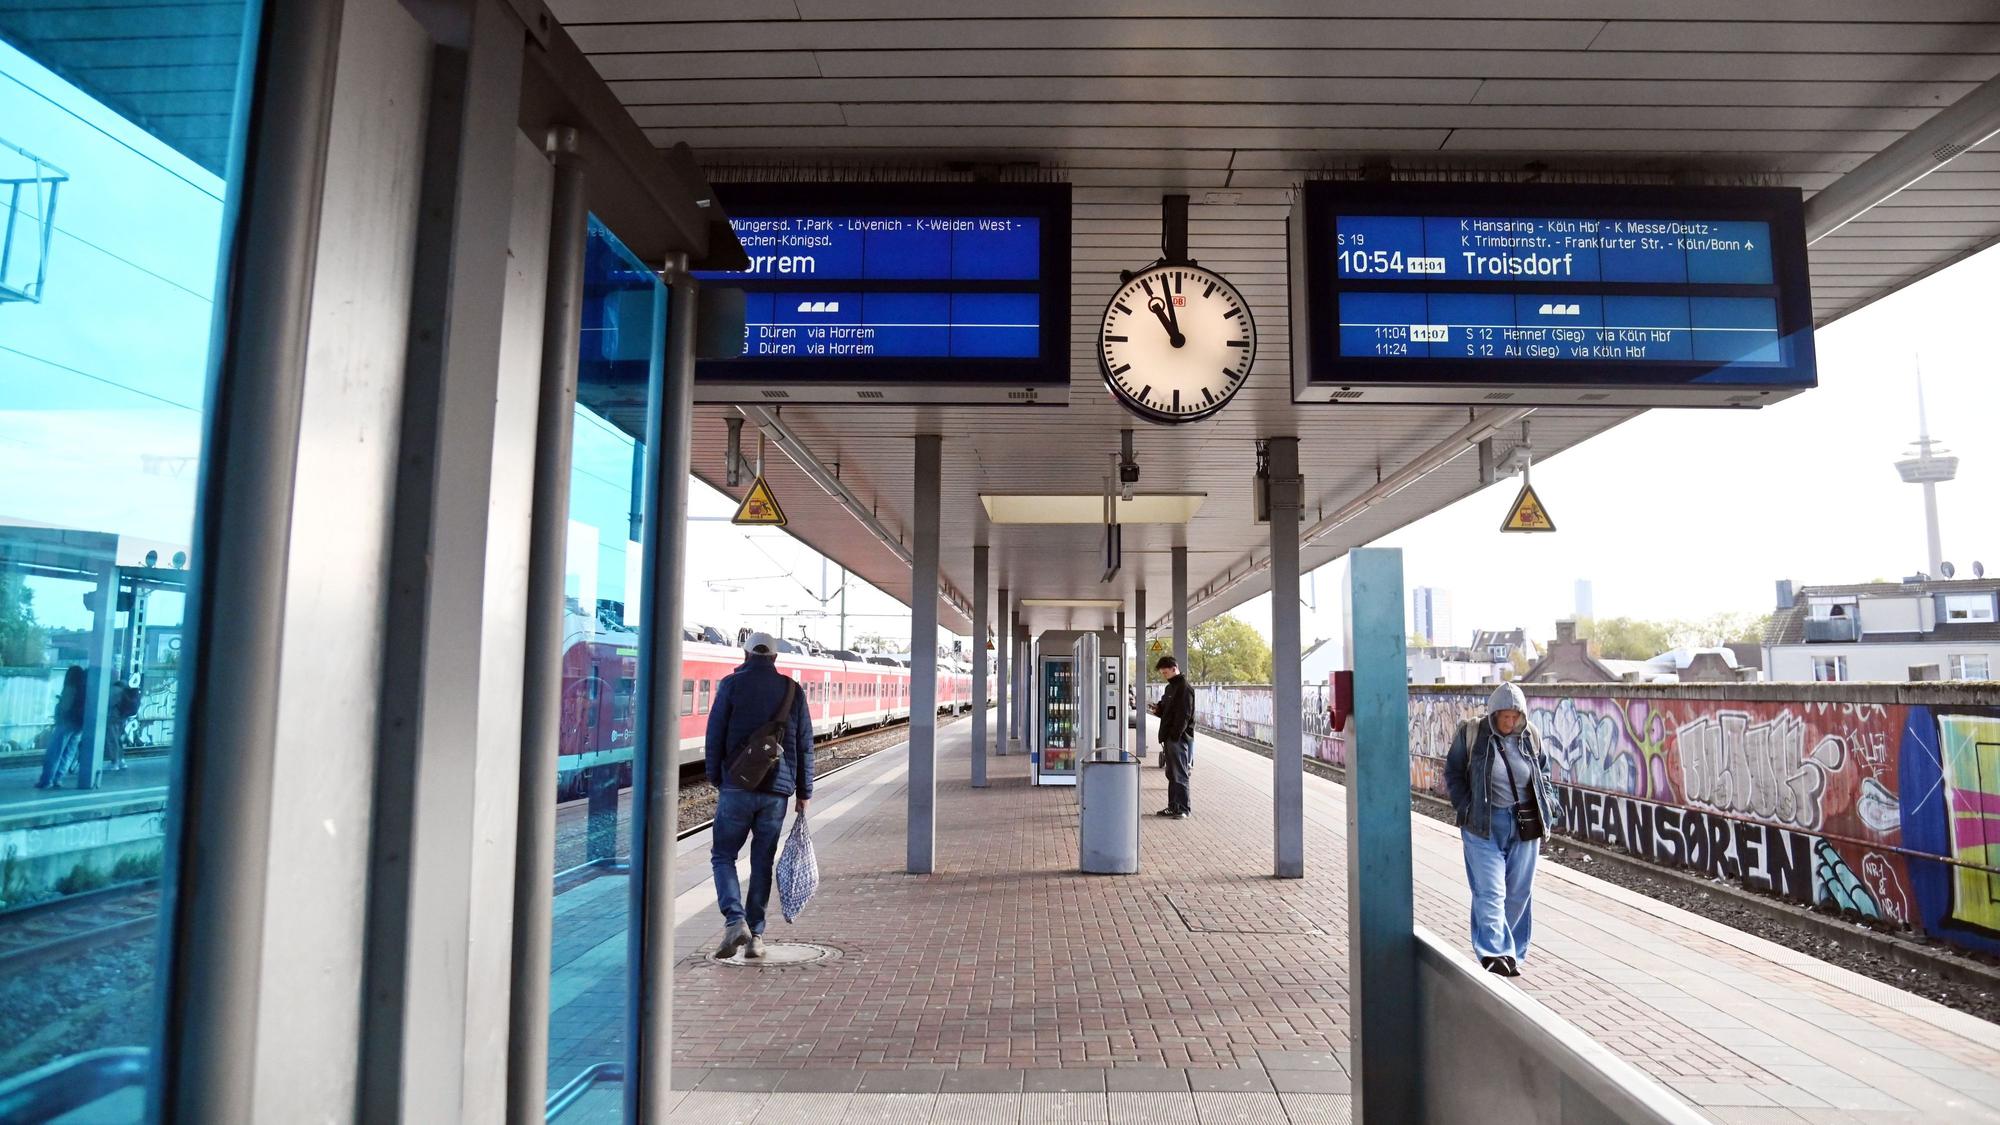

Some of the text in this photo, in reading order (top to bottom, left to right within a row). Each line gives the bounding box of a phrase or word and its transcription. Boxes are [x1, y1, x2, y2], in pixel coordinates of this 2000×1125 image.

[728, 219, 791, 233] Müngersd.
[795, 219, 834, 231] T.Park
[848, 219, 902, 231] Lövenich
[916, 219, 975, 231] K-Weiden
[979, 219, 1012, 231] West
[1460, 219, 1470, 231] K
[1473, 219, 1534, 234] Hansaring
[1547, 221, 1576, 233] Köln
[1579, 221, 1600, 233] Hbf
[1614, 222, 1623, 234] K
[1627, 222, 1709, 235] Messe/Deutz
[737, 234, 832, 248] echen-Königsd.
[1337, 233, 1364, 246] S 19
[1461, 235, 1470, 247] K
[1474, 235, 1551, 248] Trimbornstr.
[1564, 236, 1637, 249] Frankfurter
[1640, 237, 1664, 250] Str.
[1677, 238, 1740, 251] Köln/Bonn
[726, 255, 816, 274] orrem
[1338, 250, 1443, 274] 10:54 11:01
[1462, 251, 1573, 276] Troisdorf
[1172, 297, 1184, 306] DB
[760, 326, 798, 338] Düren
[806, 326, 827, 339] via
[829, 326, 876, 339] Horrem
[1374, 326, 1672, 343] 11:04 11:07 S 12 Hennef (Sieg) via Köln Hbf
[759, 342, 796, 354] Düren
[806, 342, 825, 355] via
[829, 342, 874, 355] Horrem
[1375, 343, 1646, 359] 11:24 S 12 Au (Sieg) via Köln Hbf
